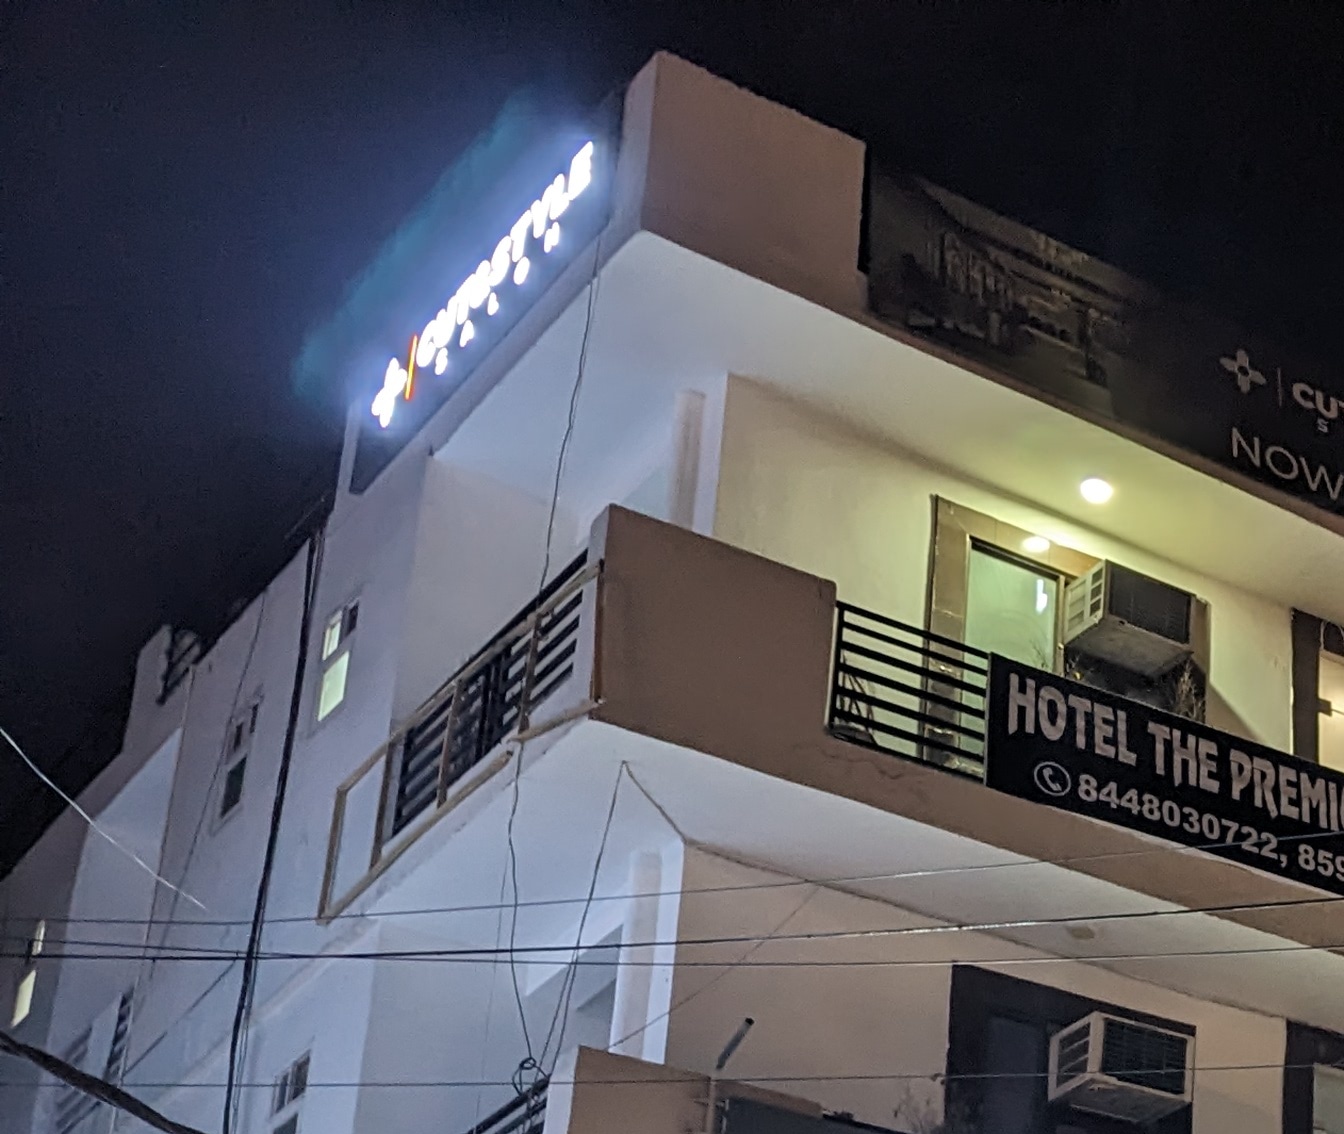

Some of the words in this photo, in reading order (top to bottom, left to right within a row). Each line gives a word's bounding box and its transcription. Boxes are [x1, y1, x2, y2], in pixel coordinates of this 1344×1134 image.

[1231, 426, 1344, 501] NOW
[1007, 671, 1138, 767] HOTEL
[1147, 720, 1221, 791] THE
[1077, 772, 1288, 868] 8448030722,
